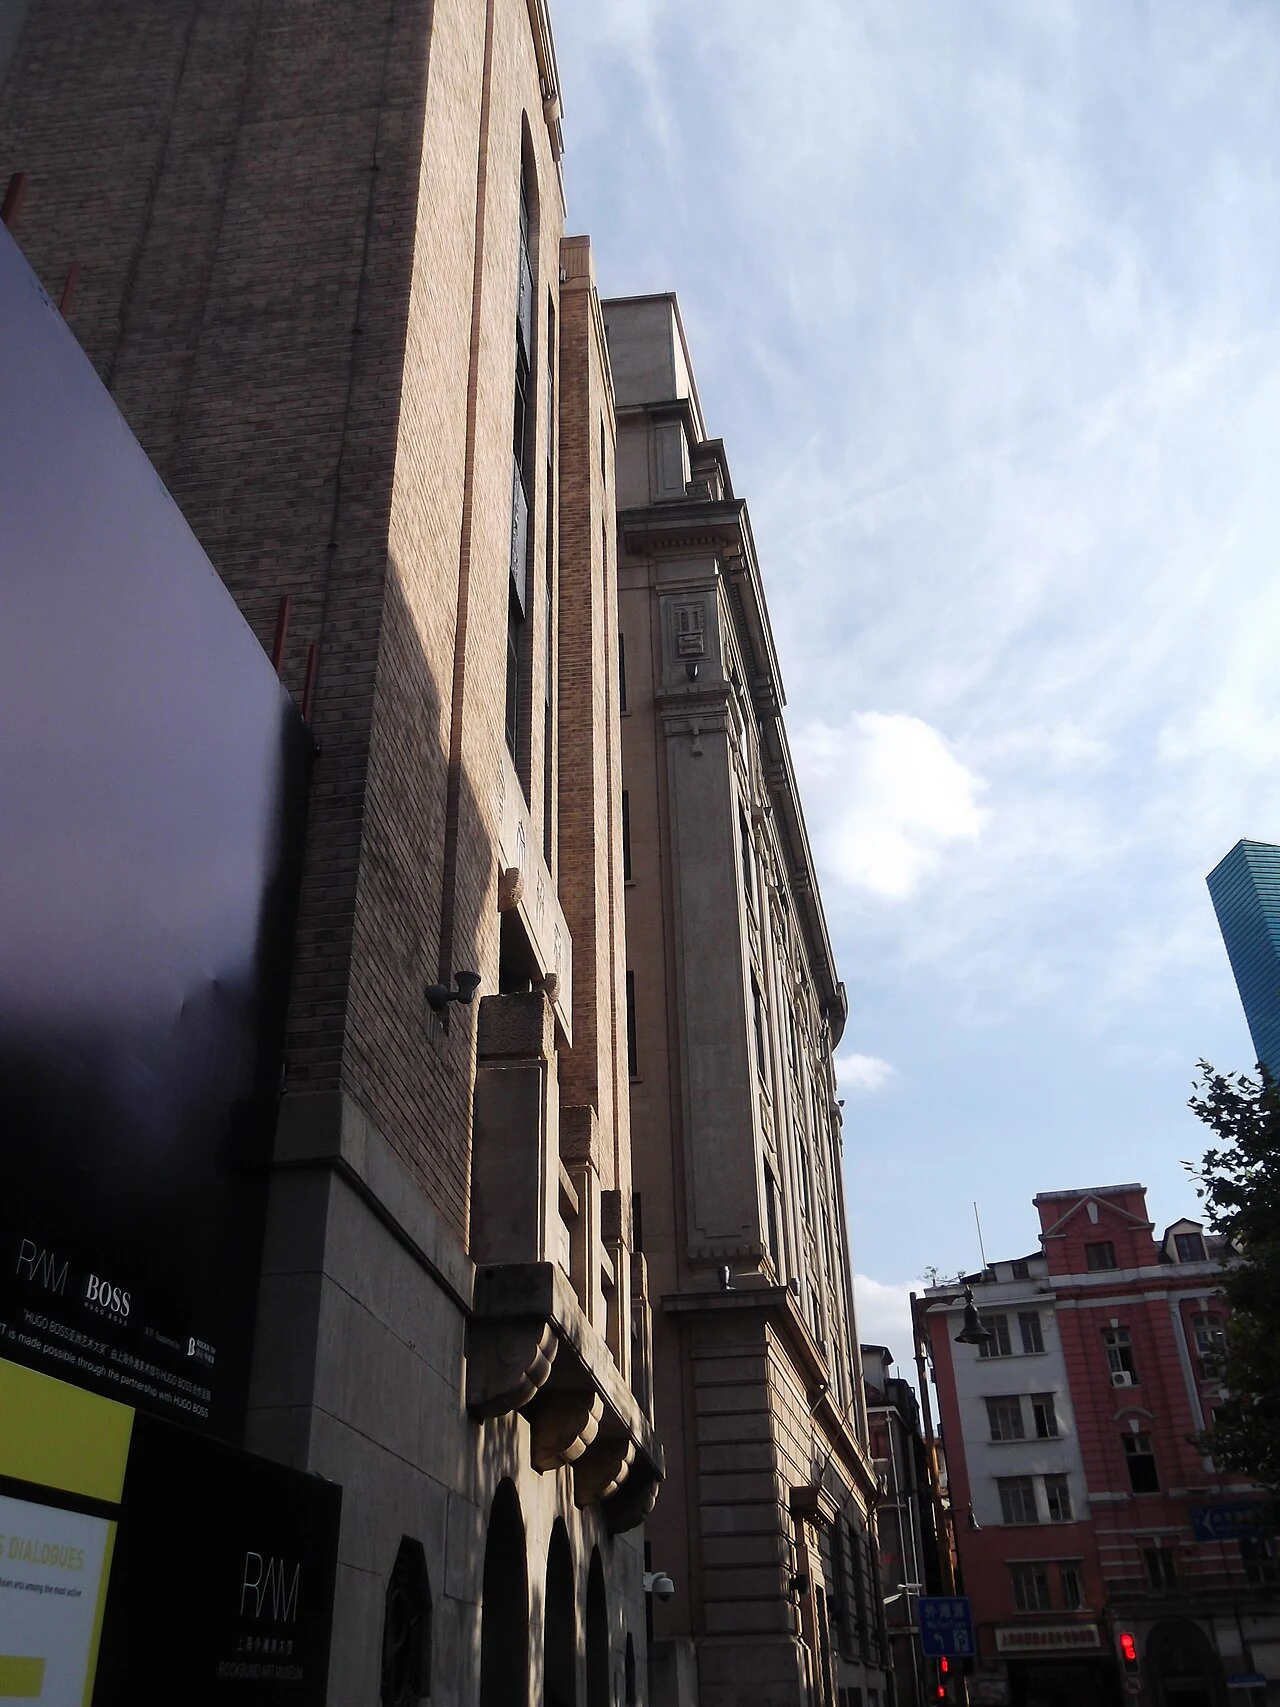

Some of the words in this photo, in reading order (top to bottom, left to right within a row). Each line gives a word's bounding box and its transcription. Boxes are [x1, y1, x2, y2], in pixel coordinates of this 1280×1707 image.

[16, 1238, 69, 1296] RAM
[85, 1273, 131, 1317] BOSS
[8, 1330, 16, 1340] is
[18, 1333, 42, 1350] made
[43, 1344, 76, 1364] possible
[77, 1356, 107, 1377] through
[108, 1368, 120, 1381] the
[120, 1375, 158, 1398] partnership
[159, 1391, 173, 1402] with
[173, 1395, 193, 1411] HUGO
[193, 1403, 210, 1418] BOSS
[8, 1536, 84, 1570] DIALOGUES
[45, 1584, 53, 1593] the
[240, 1551, 300, 1623] RAM
